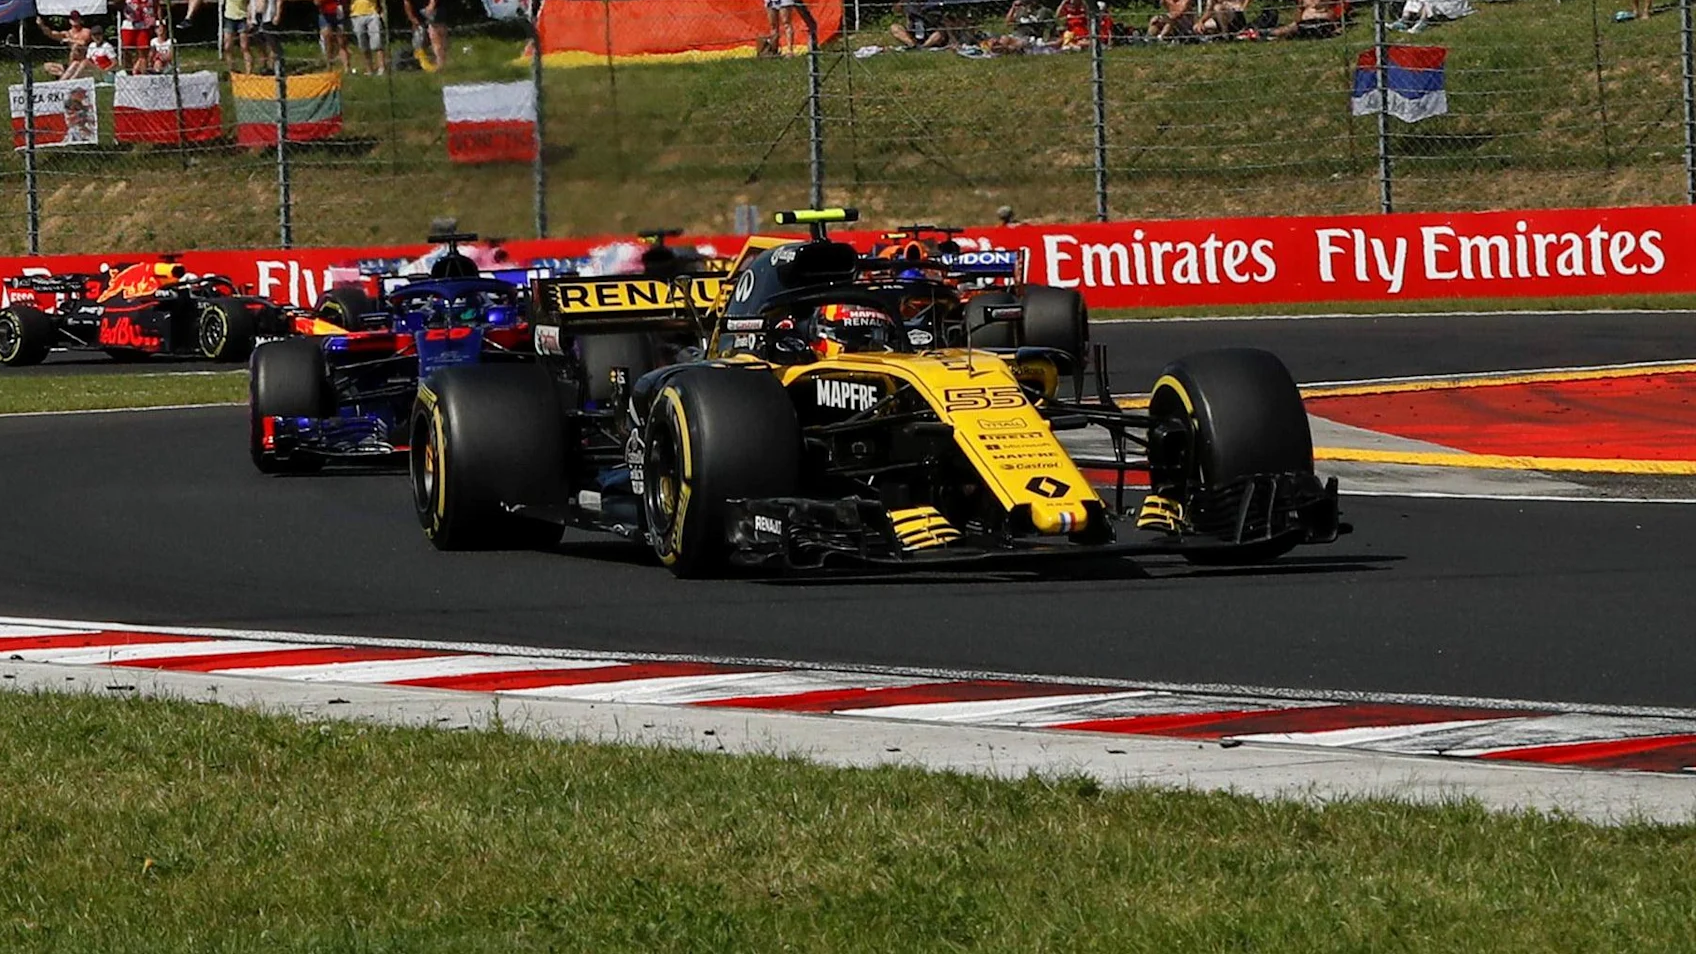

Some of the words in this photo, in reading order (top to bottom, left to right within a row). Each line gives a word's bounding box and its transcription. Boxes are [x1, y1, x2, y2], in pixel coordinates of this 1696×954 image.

[13, 94, 46, 105] FOZA
[1043, 229, 1277, 288] Emirates
[1315, 228, 1407, 293] Fly
[1420, 220, 1666, 280] Emirates
[85, 280, 102, 300] 3
[560, 277, 729, 309] RENAU
[817, 379, 878, 412] MAPFRE
[944, 386, 1027, 413] 55
[1016, 462, 1059, 470] Castrol
[754, 515, 782, 535] RENAULT
